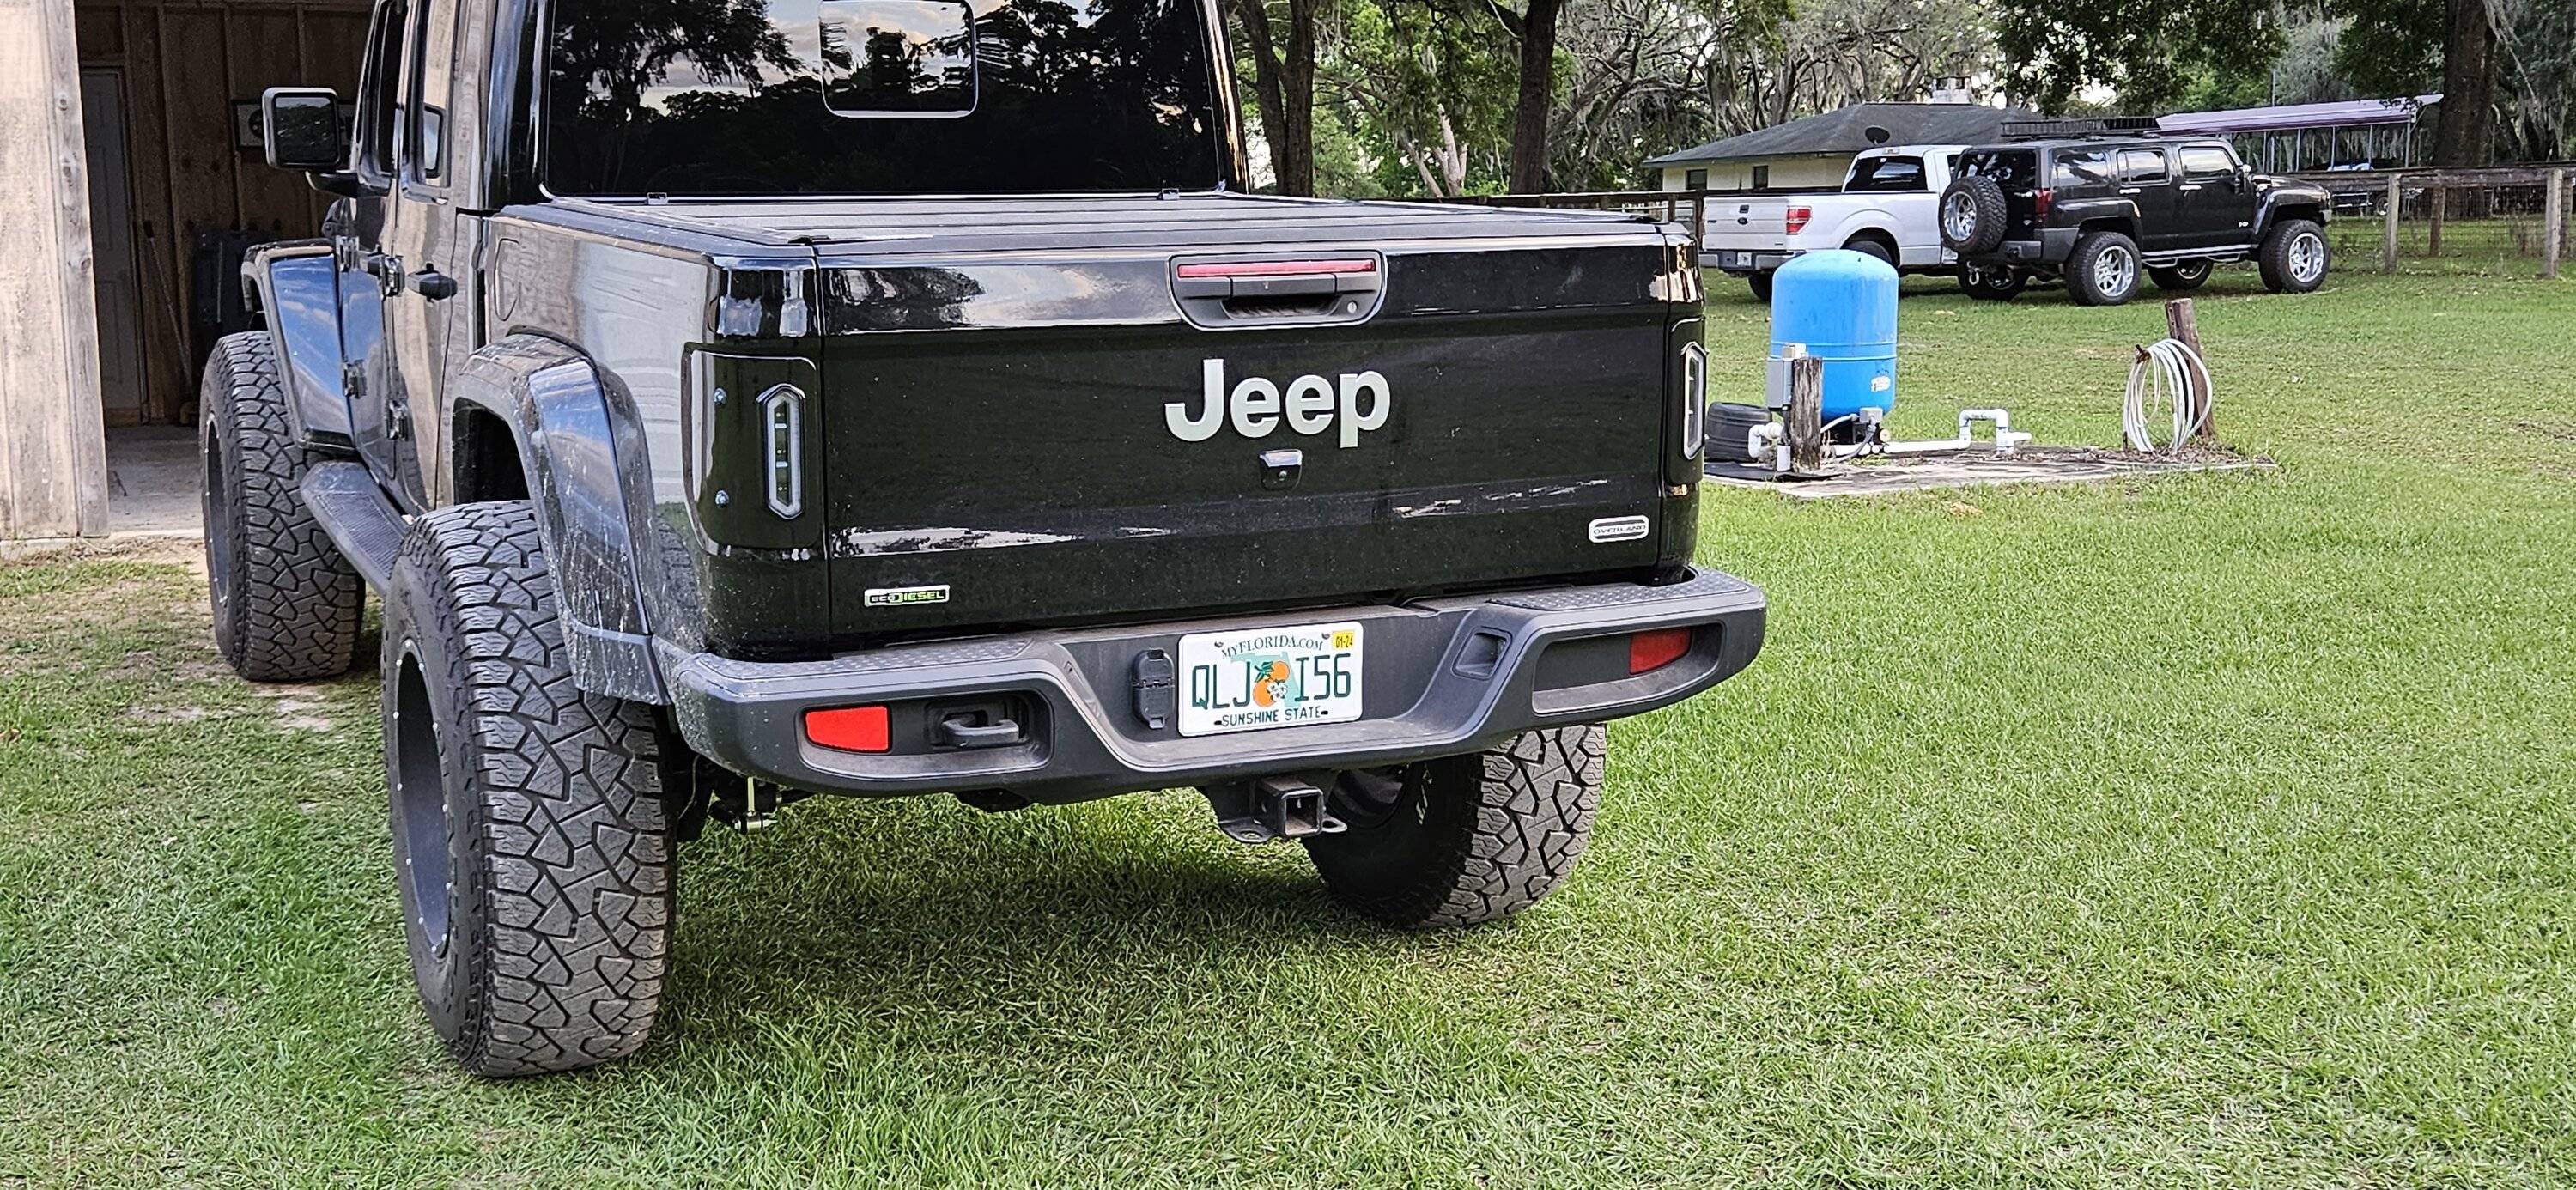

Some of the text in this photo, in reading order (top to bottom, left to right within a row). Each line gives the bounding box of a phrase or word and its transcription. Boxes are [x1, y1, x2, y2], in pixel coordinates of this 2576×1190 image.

[1164, 358, 1391, 448] Jeep
[1593, 525, 1646, 535] OVERLAND
[1221, 634, 1323, 659] MYFLORIDA.COM
[1192, 653, 1351, 710] QLJ I56
[1221, 706, 1321, 727] SUNSHINE STATE
